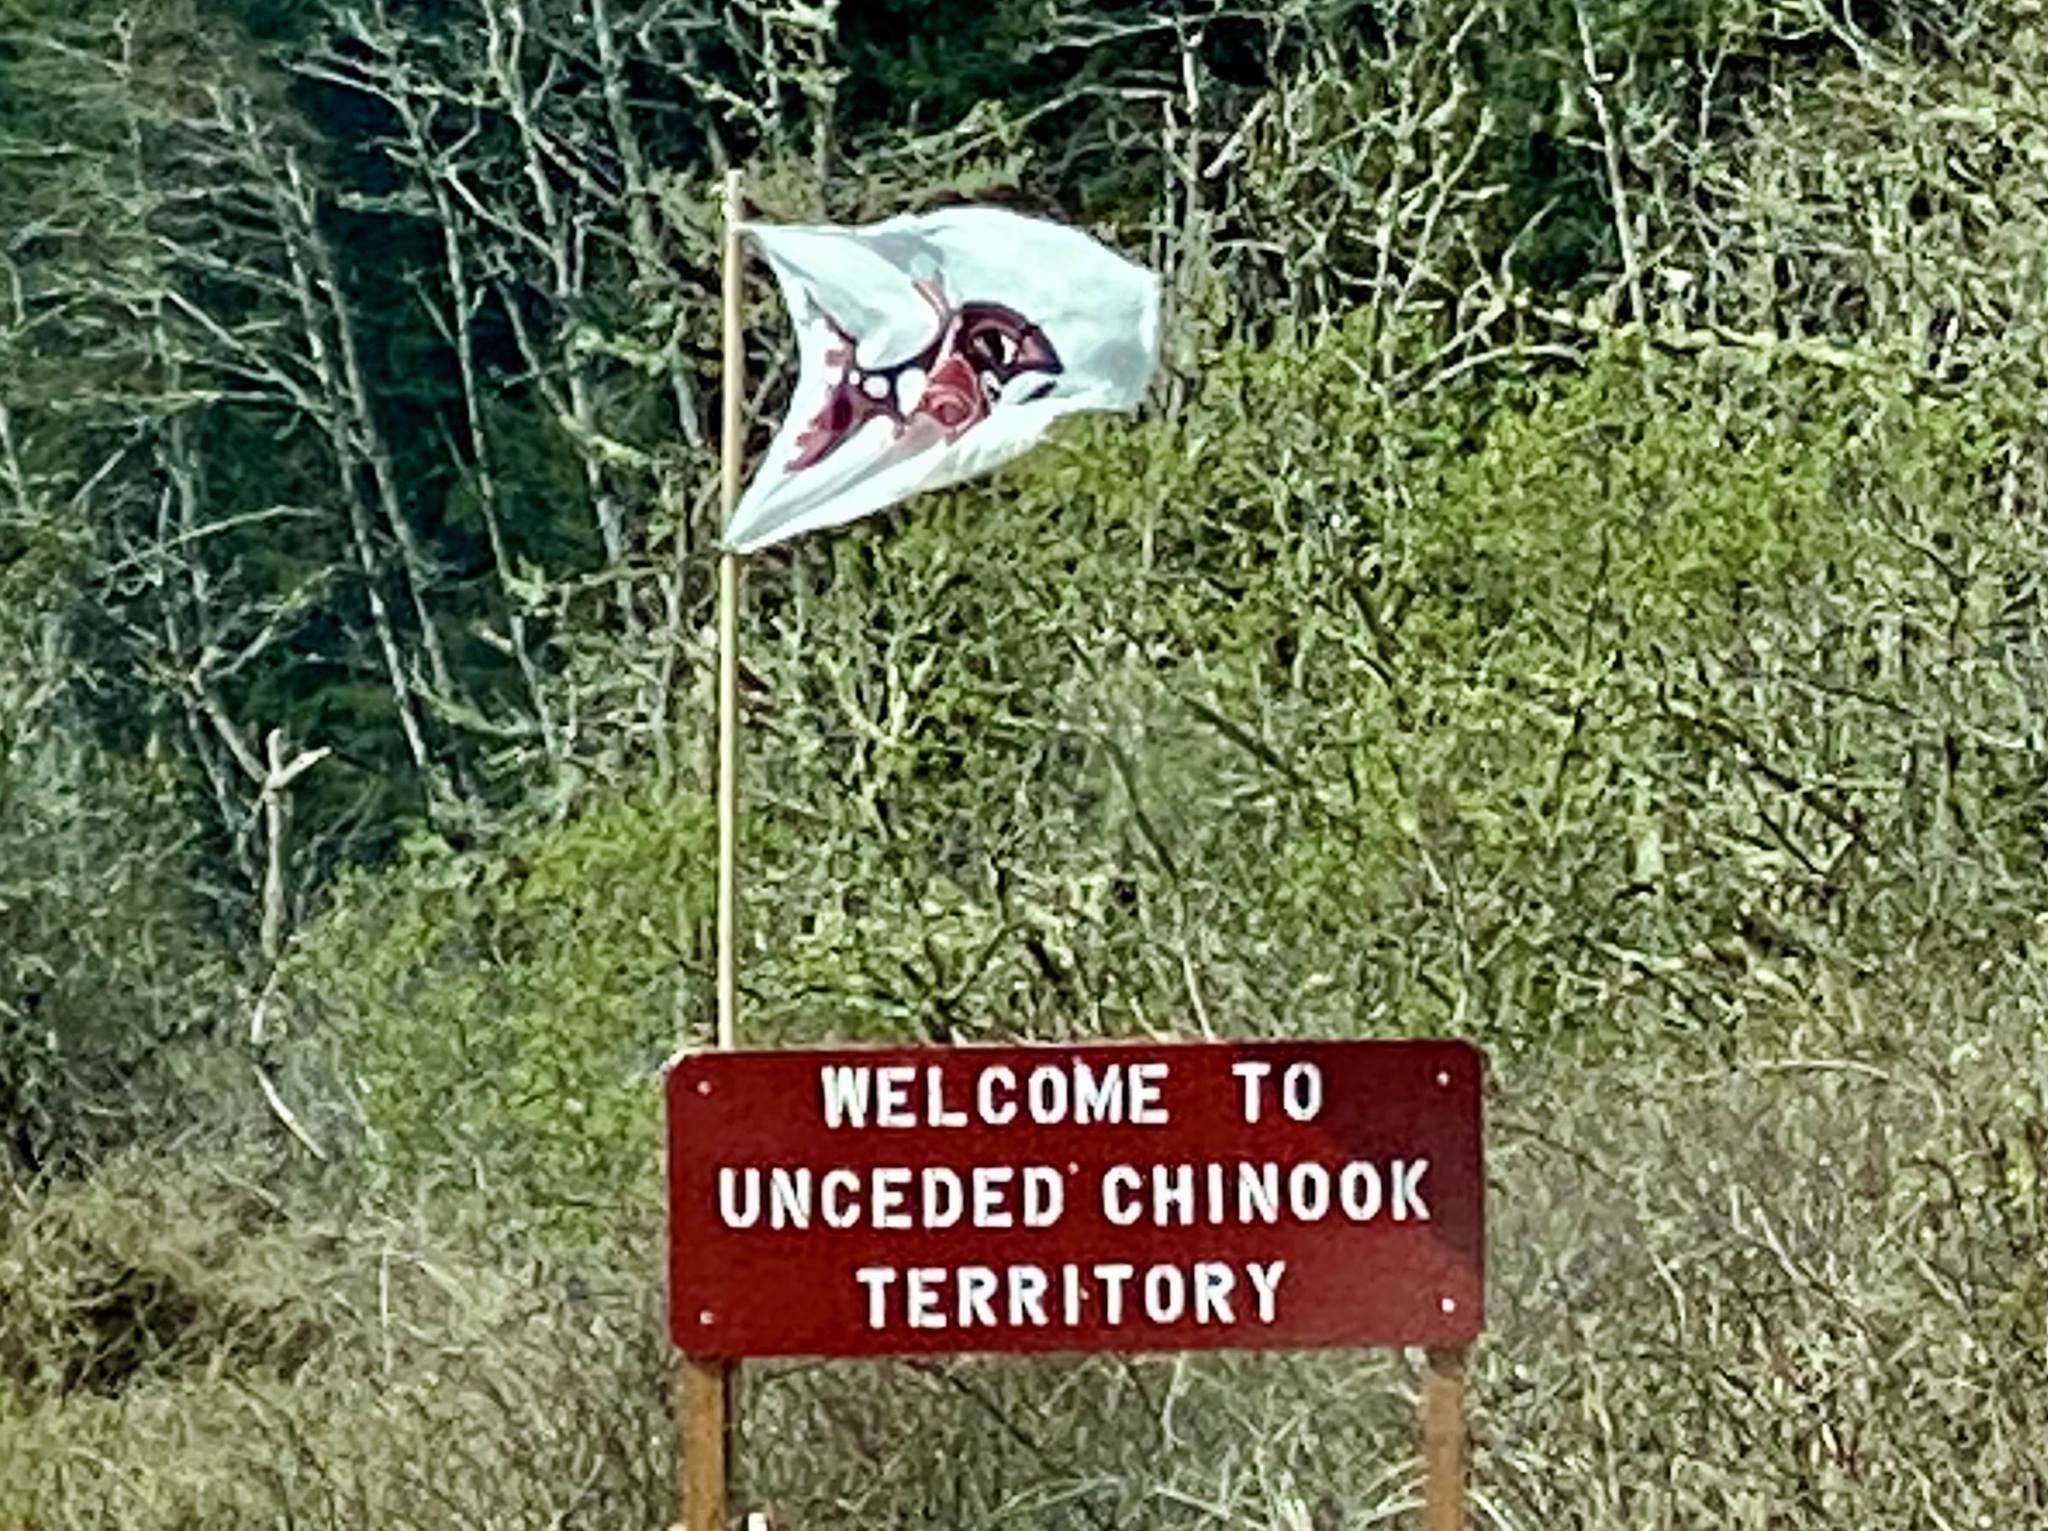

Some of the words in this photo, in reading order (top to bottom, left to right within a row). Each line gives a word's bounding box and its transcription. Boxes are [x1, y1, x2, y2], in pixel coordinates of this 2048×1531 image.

[821, 1062, 1169, 1128] WELCOME
[1231, 1061, 1322, 1123] TO
[719, 1166, 1064, 1230] UNCEDED
[1102, 1160, 1430, 1227] CHINOOK
[855, 1261, 1286, 1328] TERRITORY
